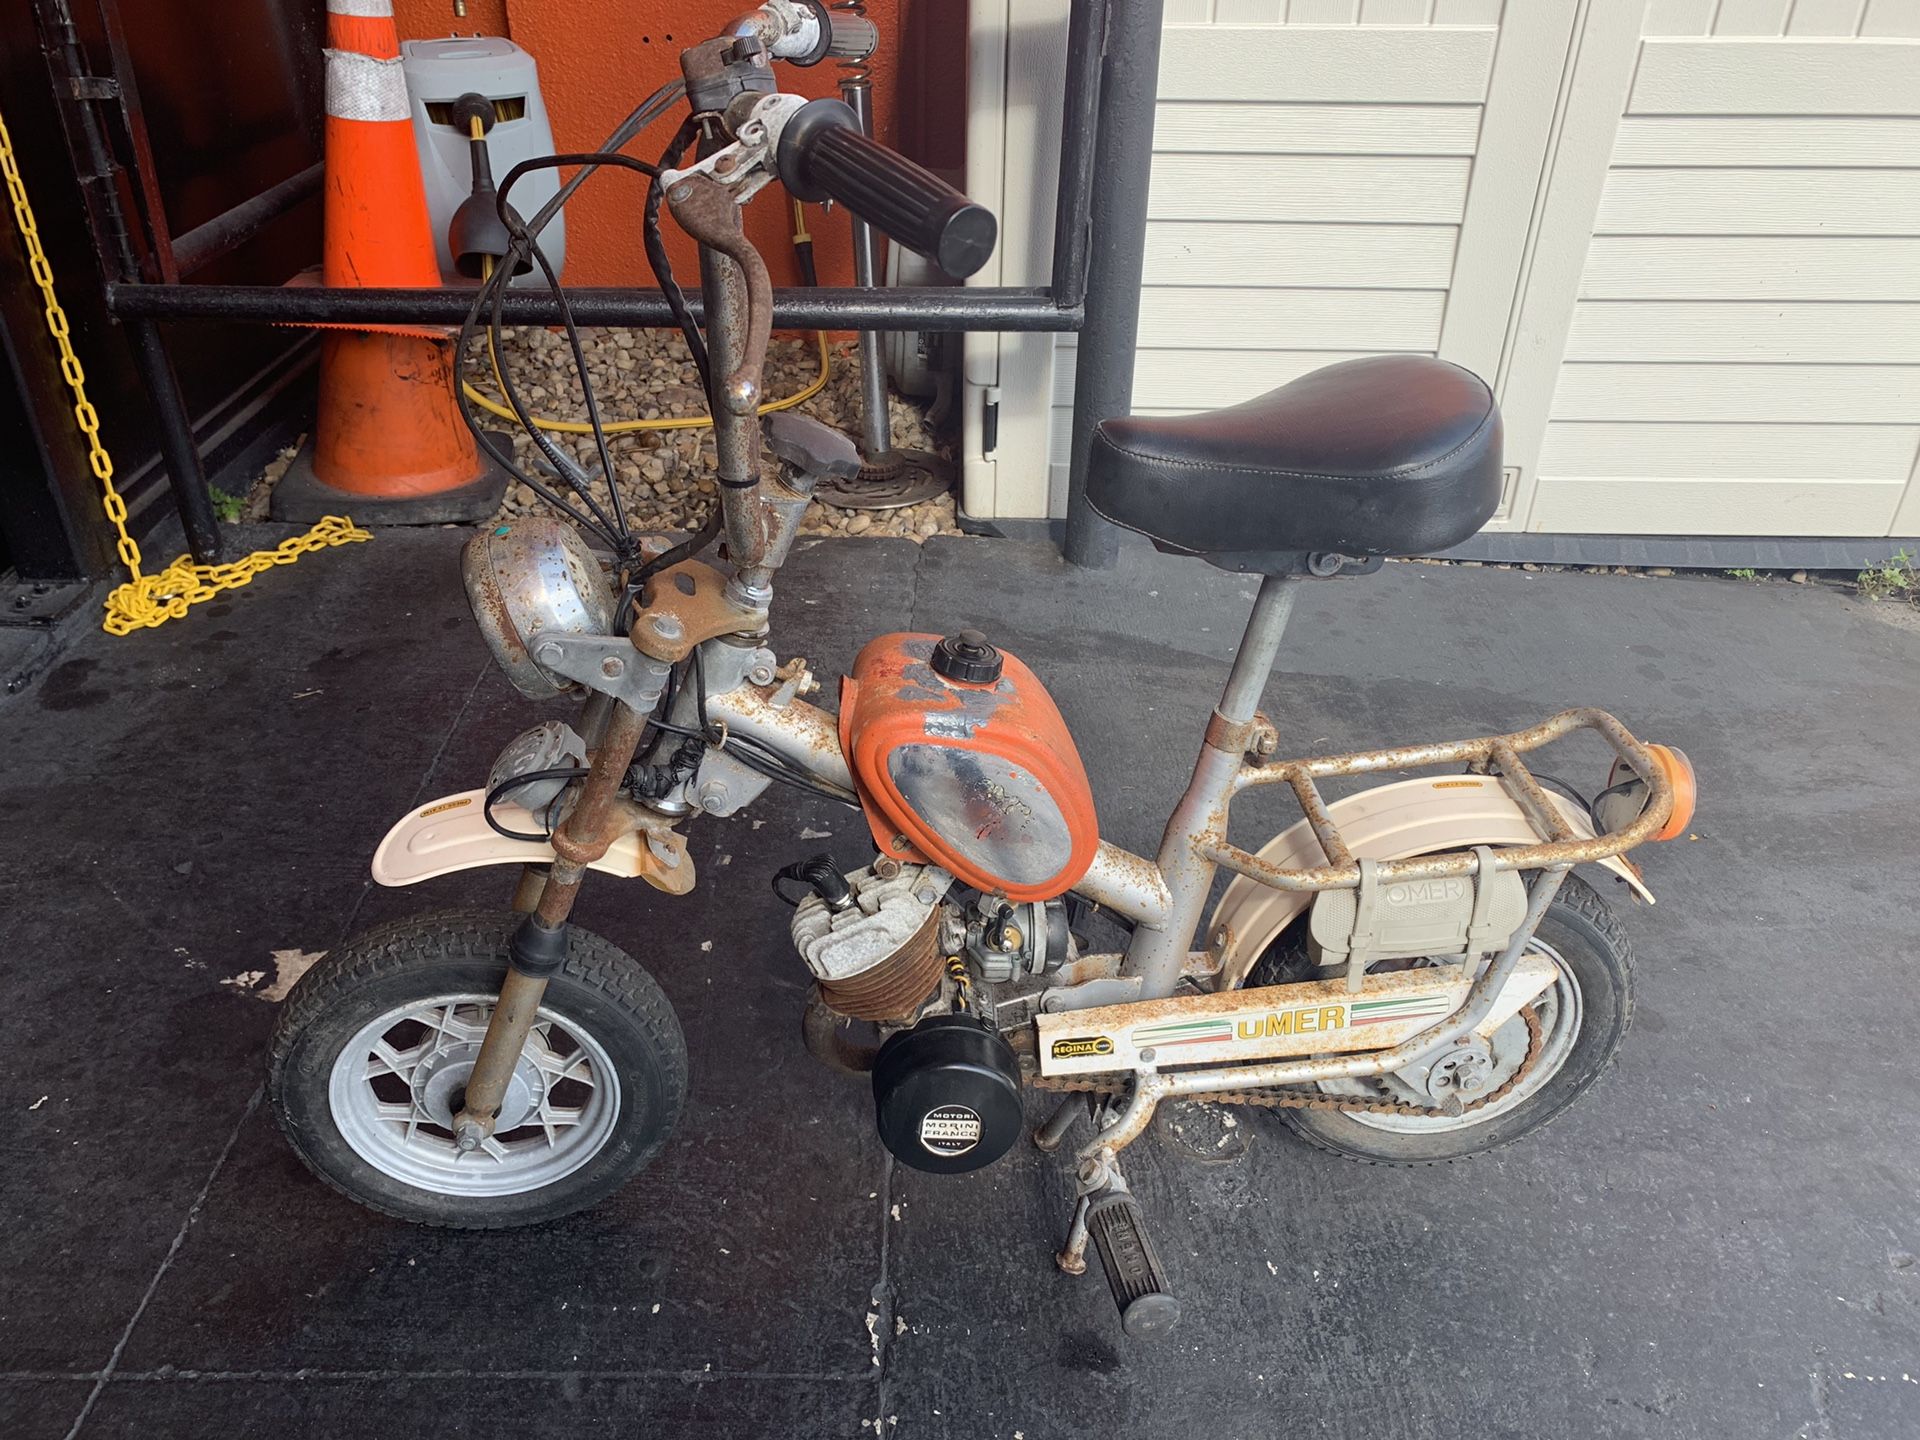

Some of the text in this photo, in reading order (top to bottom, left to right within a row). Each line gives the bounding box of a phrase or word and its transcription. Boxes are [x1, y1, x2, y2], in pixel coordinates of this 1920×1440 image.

[1389, 881, 1460, 902] OMER
[1053, 1044, 1092, 1054] REGINA
[925, 1122, 979, 1130] MORINI
